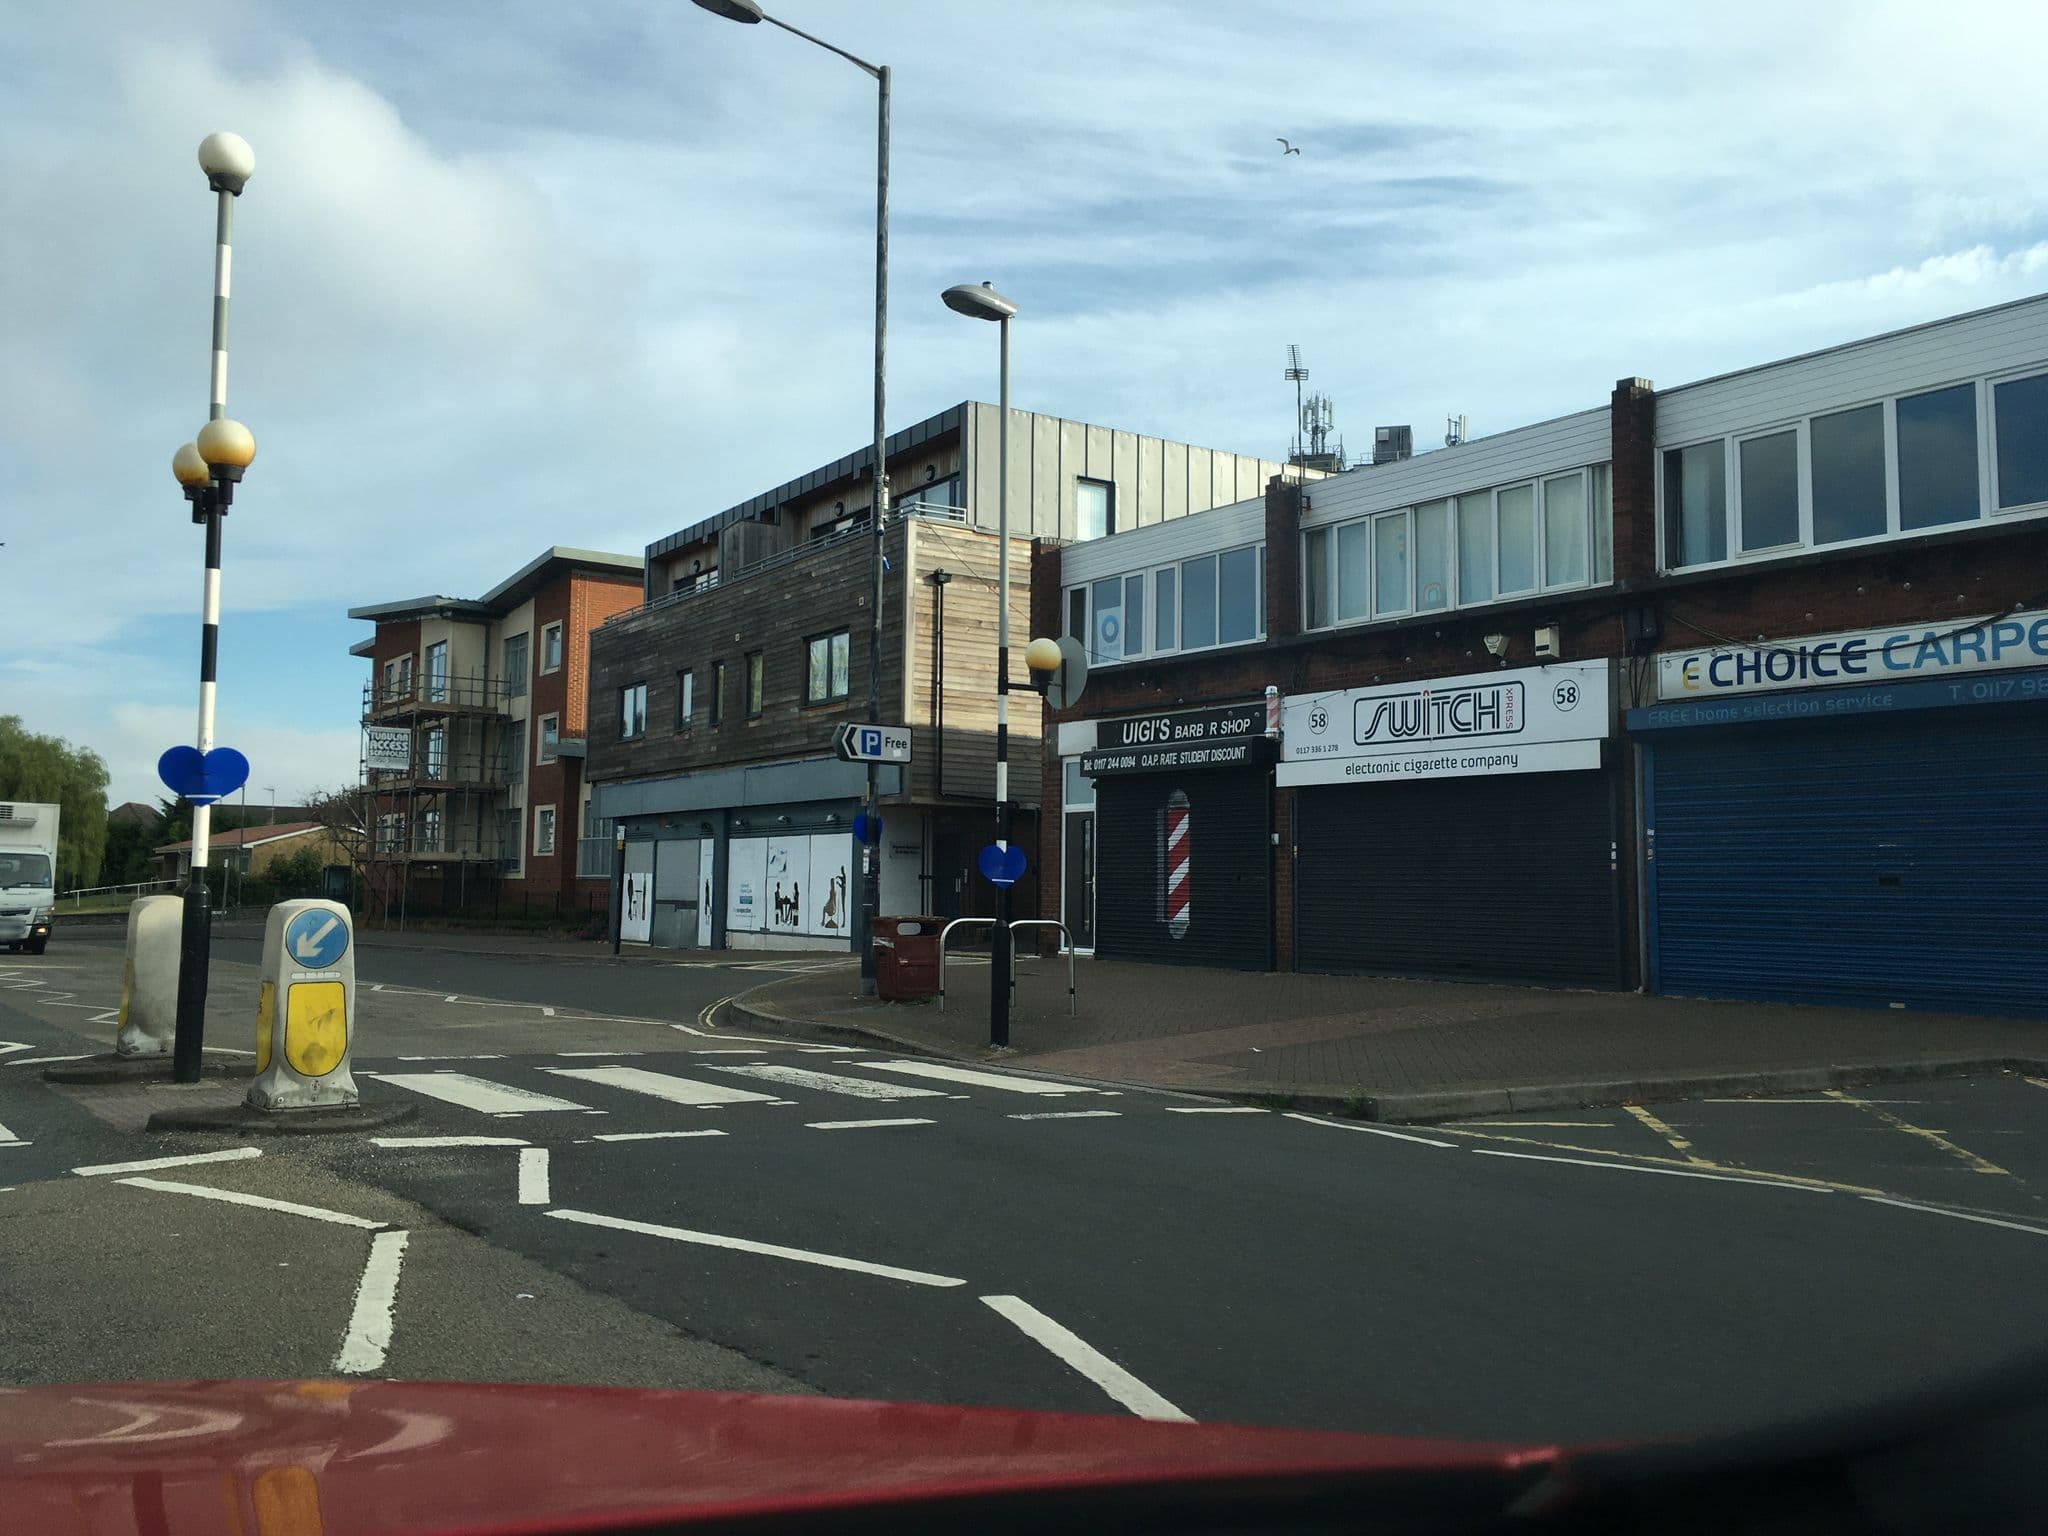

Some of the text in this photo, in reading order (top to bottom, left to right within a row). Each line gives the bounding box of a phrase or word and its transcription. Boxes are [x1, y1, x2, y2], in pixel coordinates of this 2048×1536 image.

[1708, 638, 1868, 687] CHOICE
[1556, 686, 1577, 705] 58
[1649, 708, 1689, 725] FREE
[1695, 707, 1738, 722] home
[1743, 699, 1819, 720] selection
[1825, 692, 1893, 710] service
[1973, 680, 2015, 699] 0117
[1505, 687, 1514, 730] XPRESS
[1220, 718, 1251, 735] SHOP
[1311, 713, 1326, 728] 58
[370, 740, 409, 751] ACCESS
[885, 736, 908, 749] Free
[1160, 753, 1178, 765] RATE
[1180, 750, 1210, 764] STUDENT
[1211, 746, 1246, 761] DISCOUNT
[1345, 754, 1519, 776] electronic cigarette company
